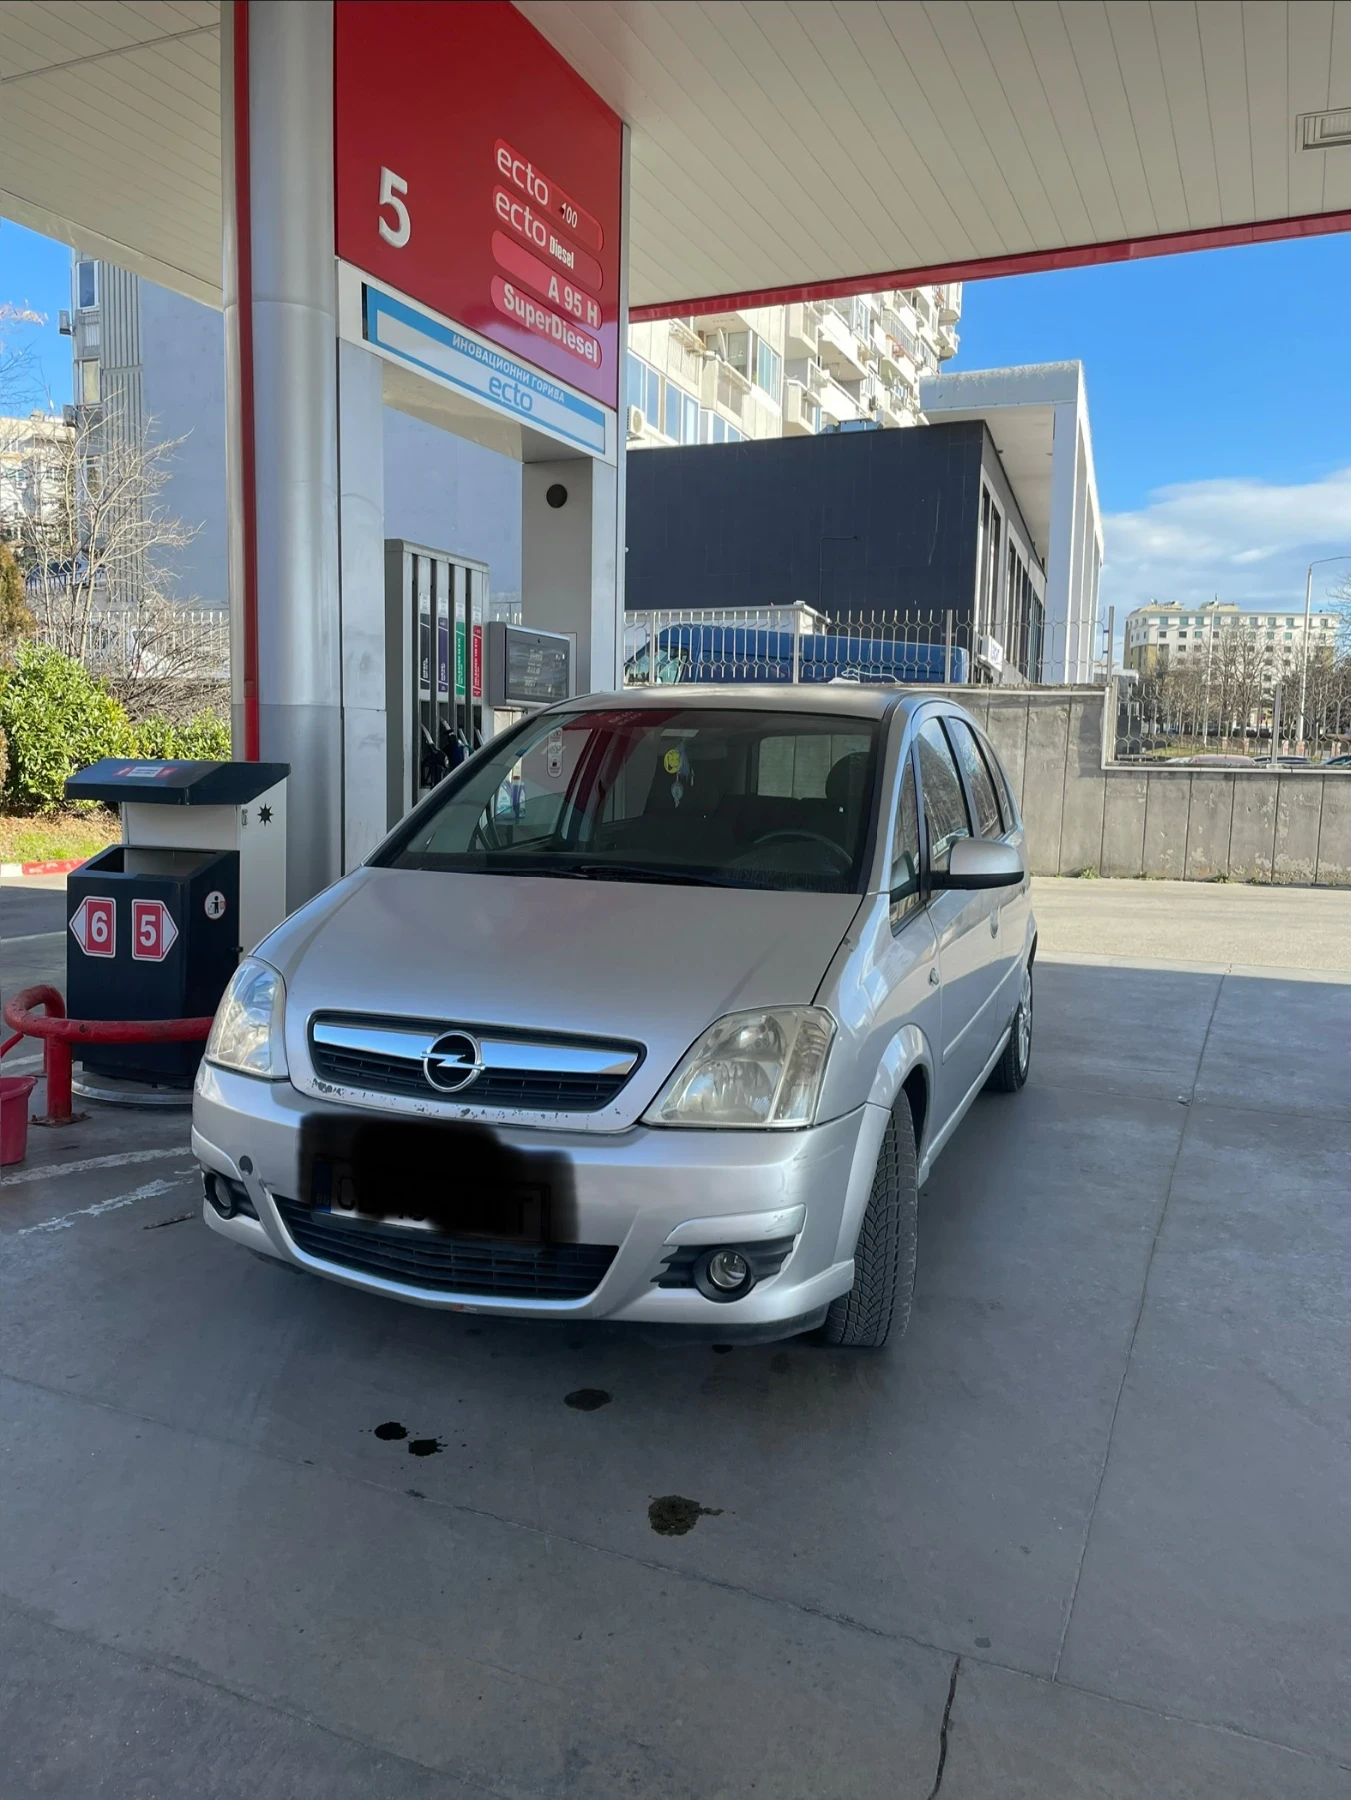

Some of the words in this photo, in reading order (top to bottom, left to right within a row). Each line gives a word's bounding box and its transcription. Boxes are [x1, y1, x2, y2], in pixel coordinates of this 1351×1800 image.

[378, 165, 411, 249] 5
[497, 147, 549, 206] ecto
[561, 202, 578, 228] 100
[496, 191, 546, 247] ecto
[549, 235, 574, 270] Diesel
[503, 283, 598, 363] SuperDiesel
[548, 275, 560, 304] A
[564, 285, 582, 317] 95
[587, 301, 598, 328] H
[452, 334, 530, 382] ИНОВАЦИОННИ
[531, 376, 565, 403] ГОРИВА
[488, 376, 533, 413] ecto
[91, 910, 108, 943] 6
[139, 914, 157, 947] 5
